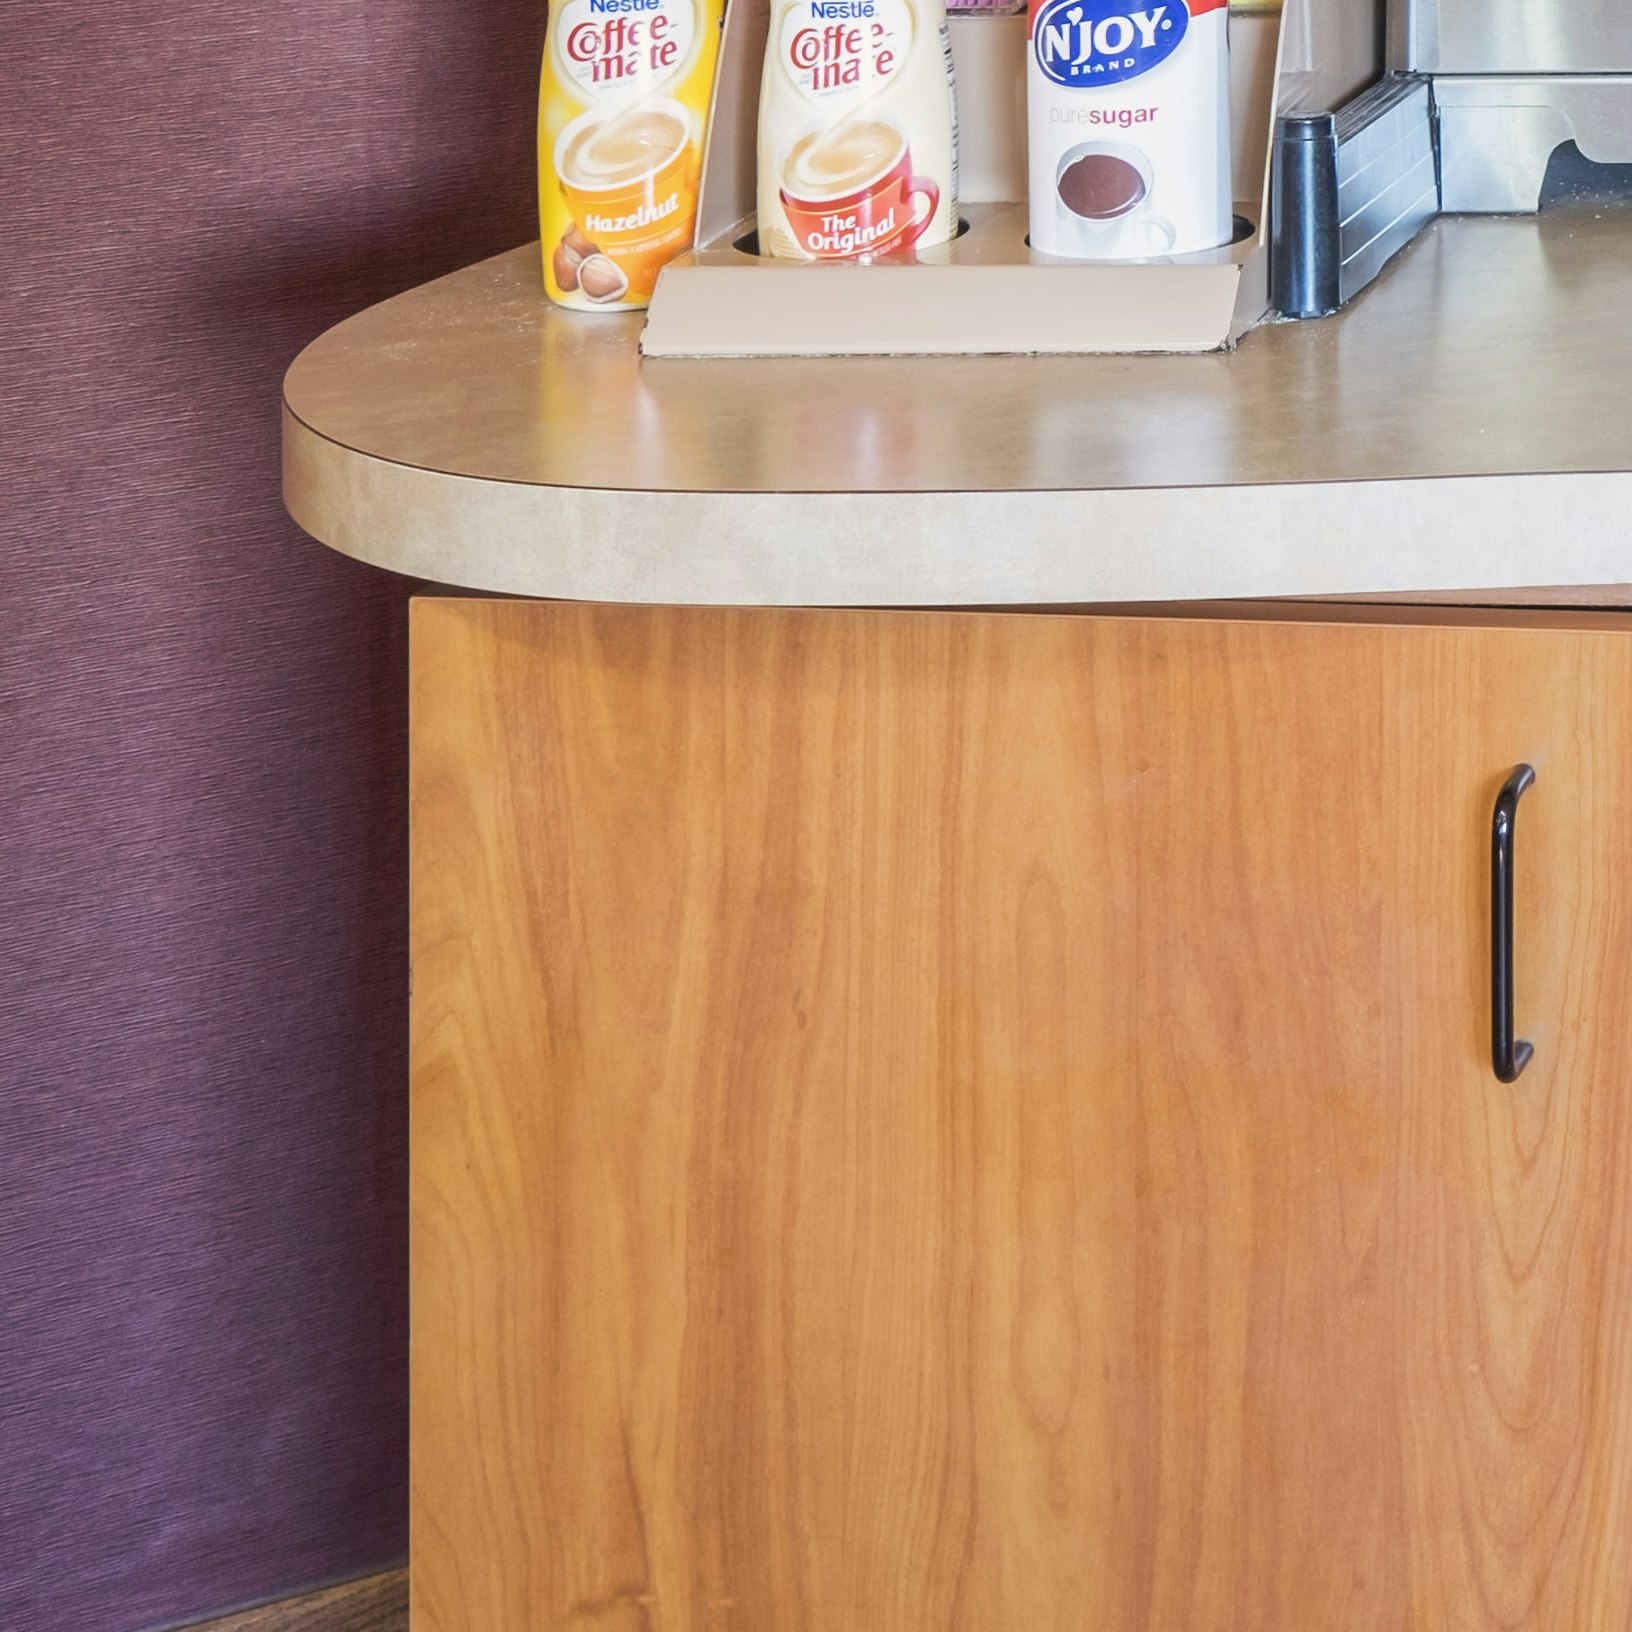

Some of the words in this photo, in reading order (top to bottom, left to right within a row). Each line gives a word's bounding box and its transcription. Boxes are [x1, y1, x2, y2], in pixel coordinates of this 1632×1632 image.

[811, 0, 875, 19] Nestlé
[1070, 58, 1136, 76] BRAND
[585, 192, 680, 233] Hazelnut
[807, 207, 896, 254] Original
[821, 214, 856, 234] The
